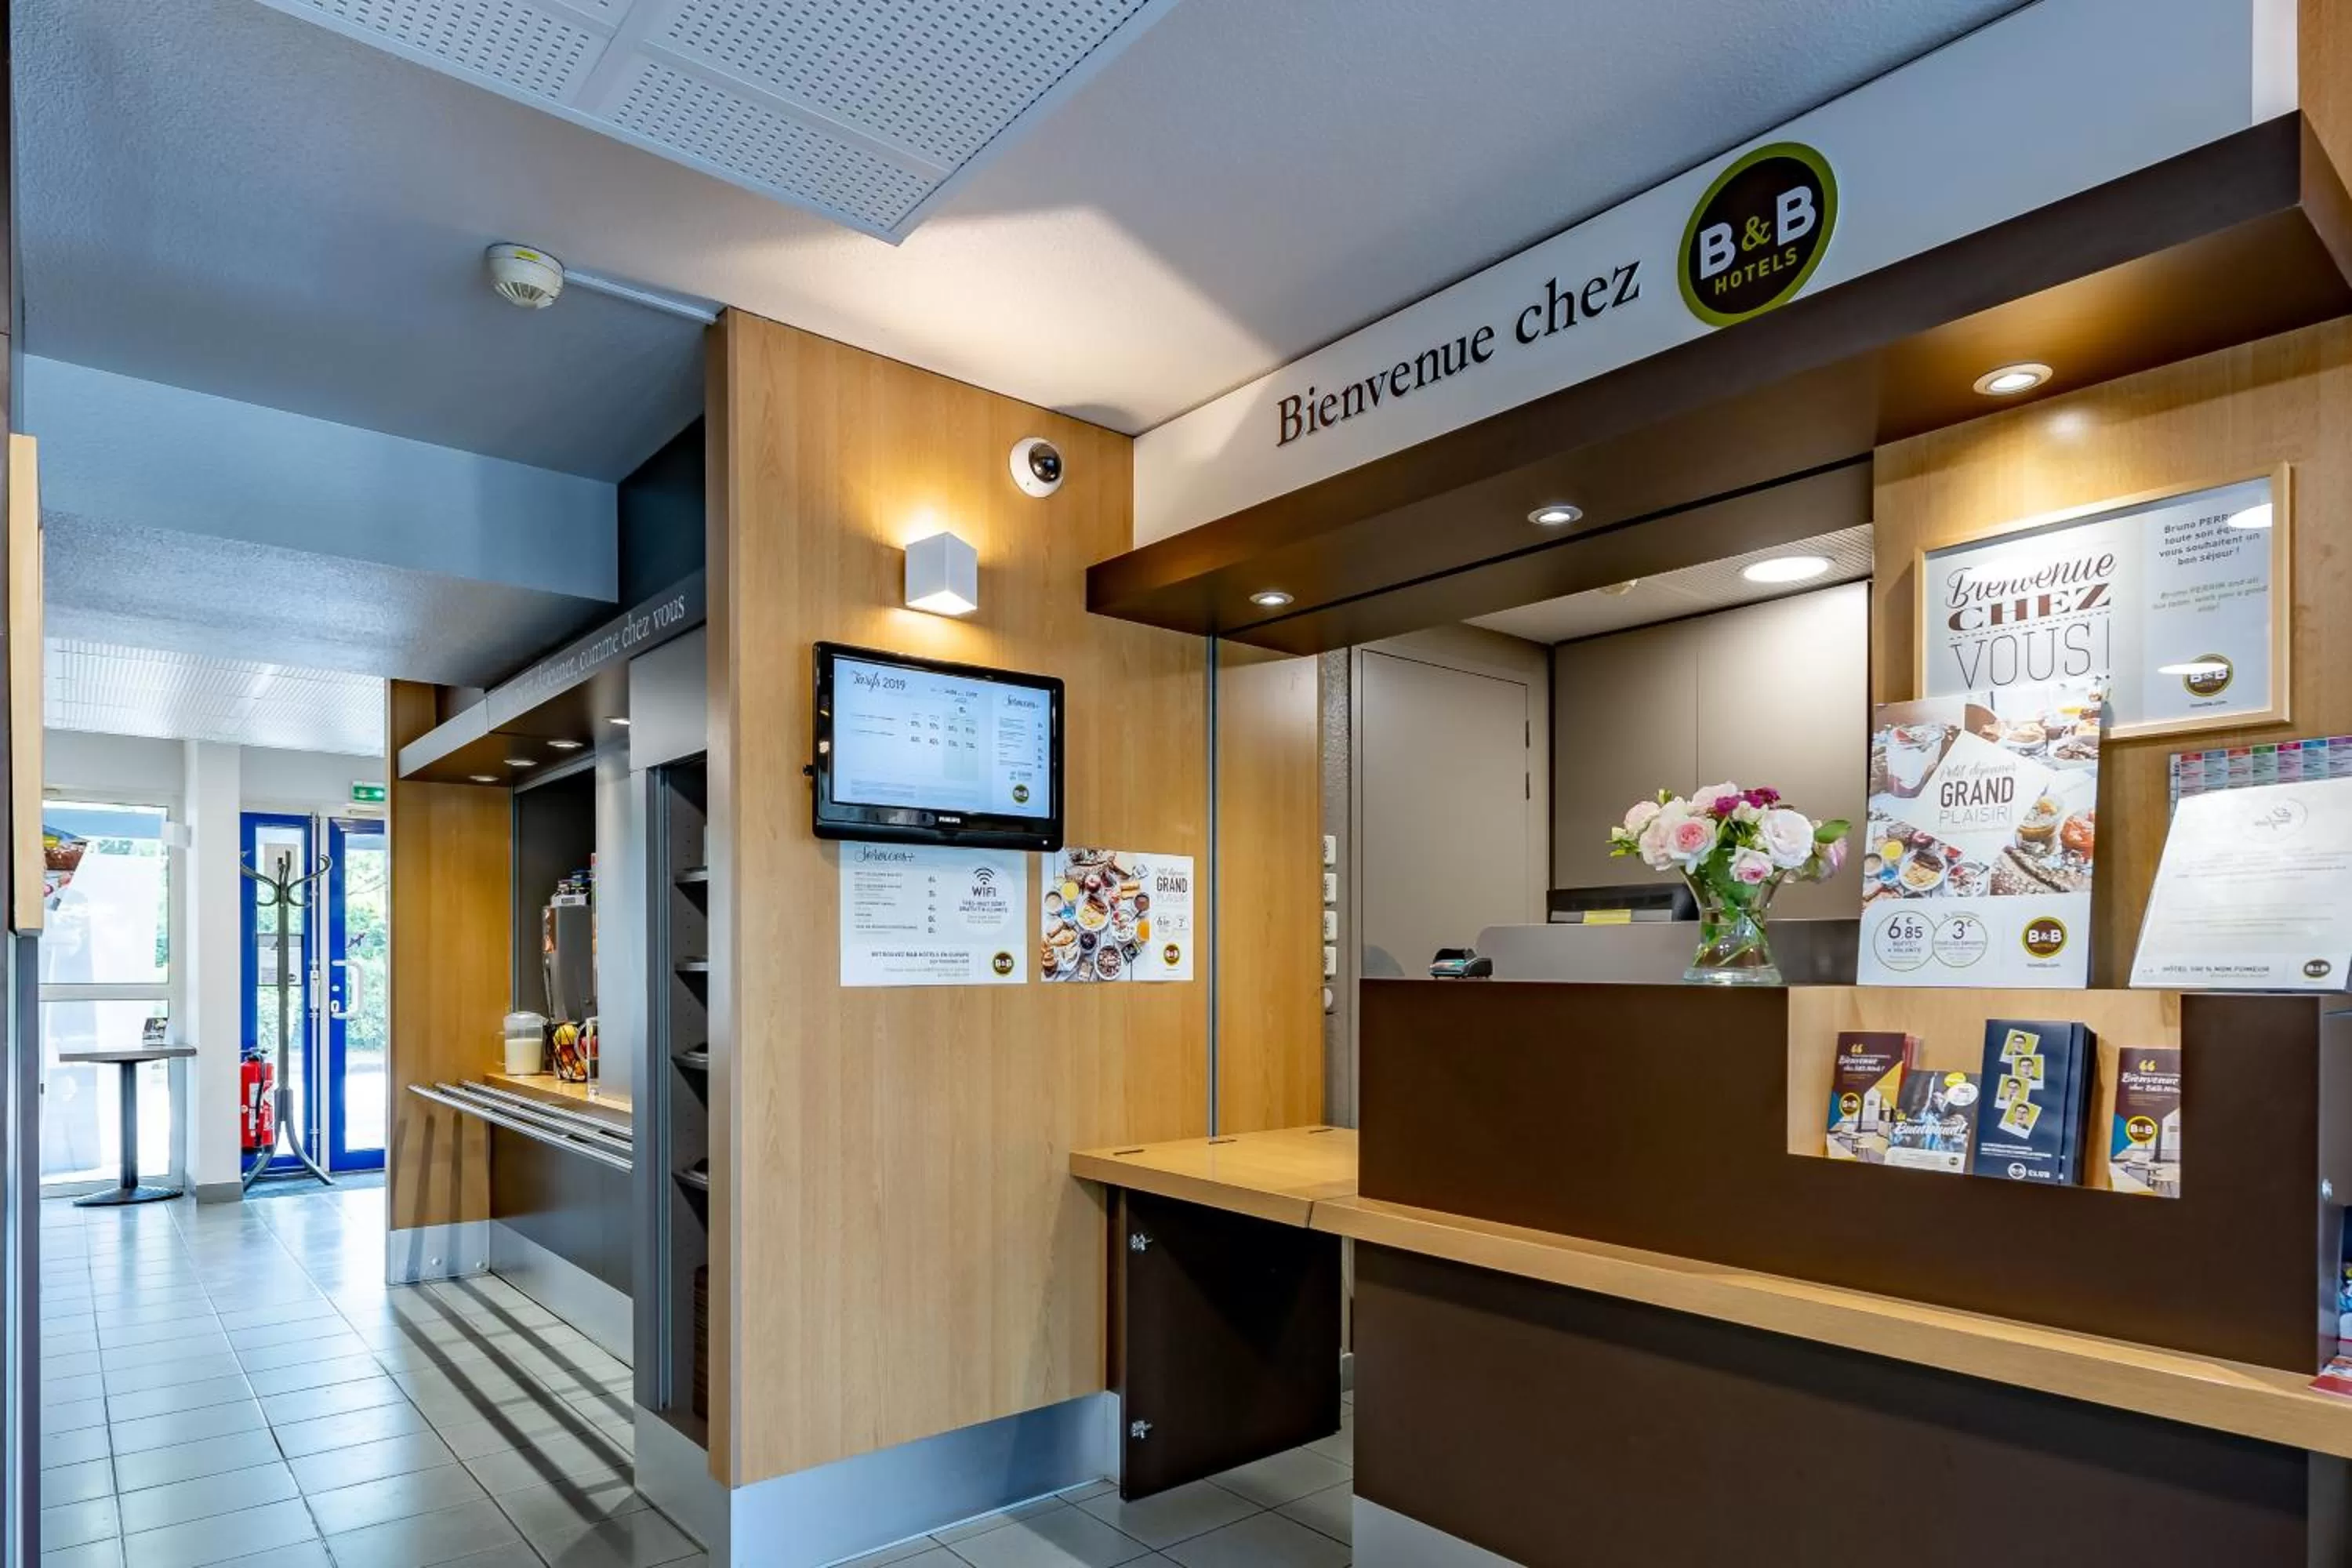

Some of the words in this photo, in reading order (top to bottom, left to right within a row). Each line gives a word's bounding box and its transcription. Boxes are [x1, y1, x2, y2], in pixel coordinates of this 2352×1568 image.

[1715, 247, 1798, 296] HOTELS
[1276, 323, 1495, 448] Bienvenue
[1515, 260, 1642, 345] chez
[2164, 522, 2196, 534] Bruno
[2165, 535, 2192, 546] toute
[2195, 529, 2214, 539] son
[2159, 548, 2183, 557] vous
[2186, 535, 2243, 551] souhaitent
[2245, 532, 2260, 541] un
[2177, 556, 2198, 565] bon
[2199, 549, 2234, 562] séjour
[1946, 553, 2116, 609] Bienvenue
[1948, 583, 2111, 631] CHEZ
[579, 633, 619, 671] comme
[622, 614, 650, 650] chez
[653, 593, 685, 631] vous
[1940, 776, 2014, 808] GRAND
[971, 885, 996, 898] WIFI
[1156, 877, 1188, 893] GRAND
[2027, 929, 2062, 943] B&B
[2122, 1072, 2179, 1084] Bienvenue
